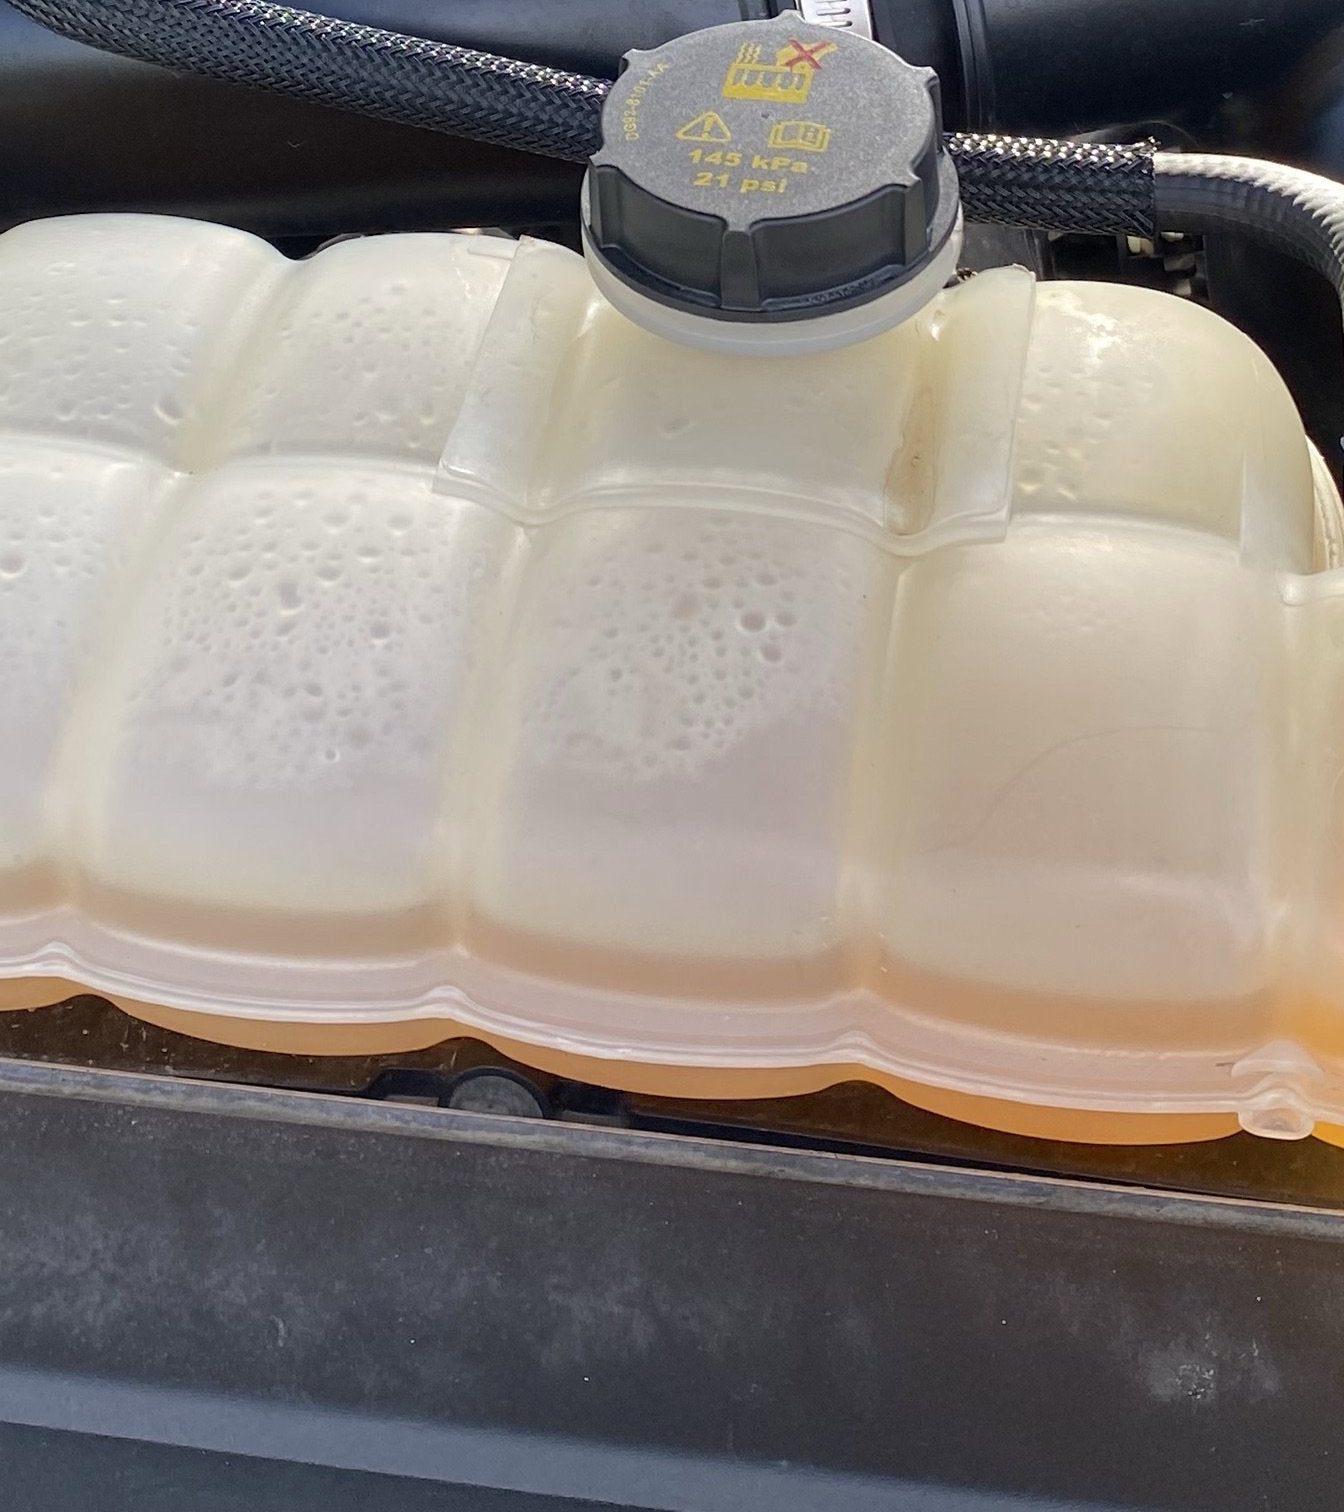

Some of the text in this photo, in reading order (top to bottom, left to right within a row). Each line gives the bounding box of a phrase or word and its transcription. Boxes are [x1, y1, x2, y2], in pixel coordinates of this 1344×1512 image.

[688, 147, 809, 174] 145 kPa
[693, 171, 787, 194] 21 psi
